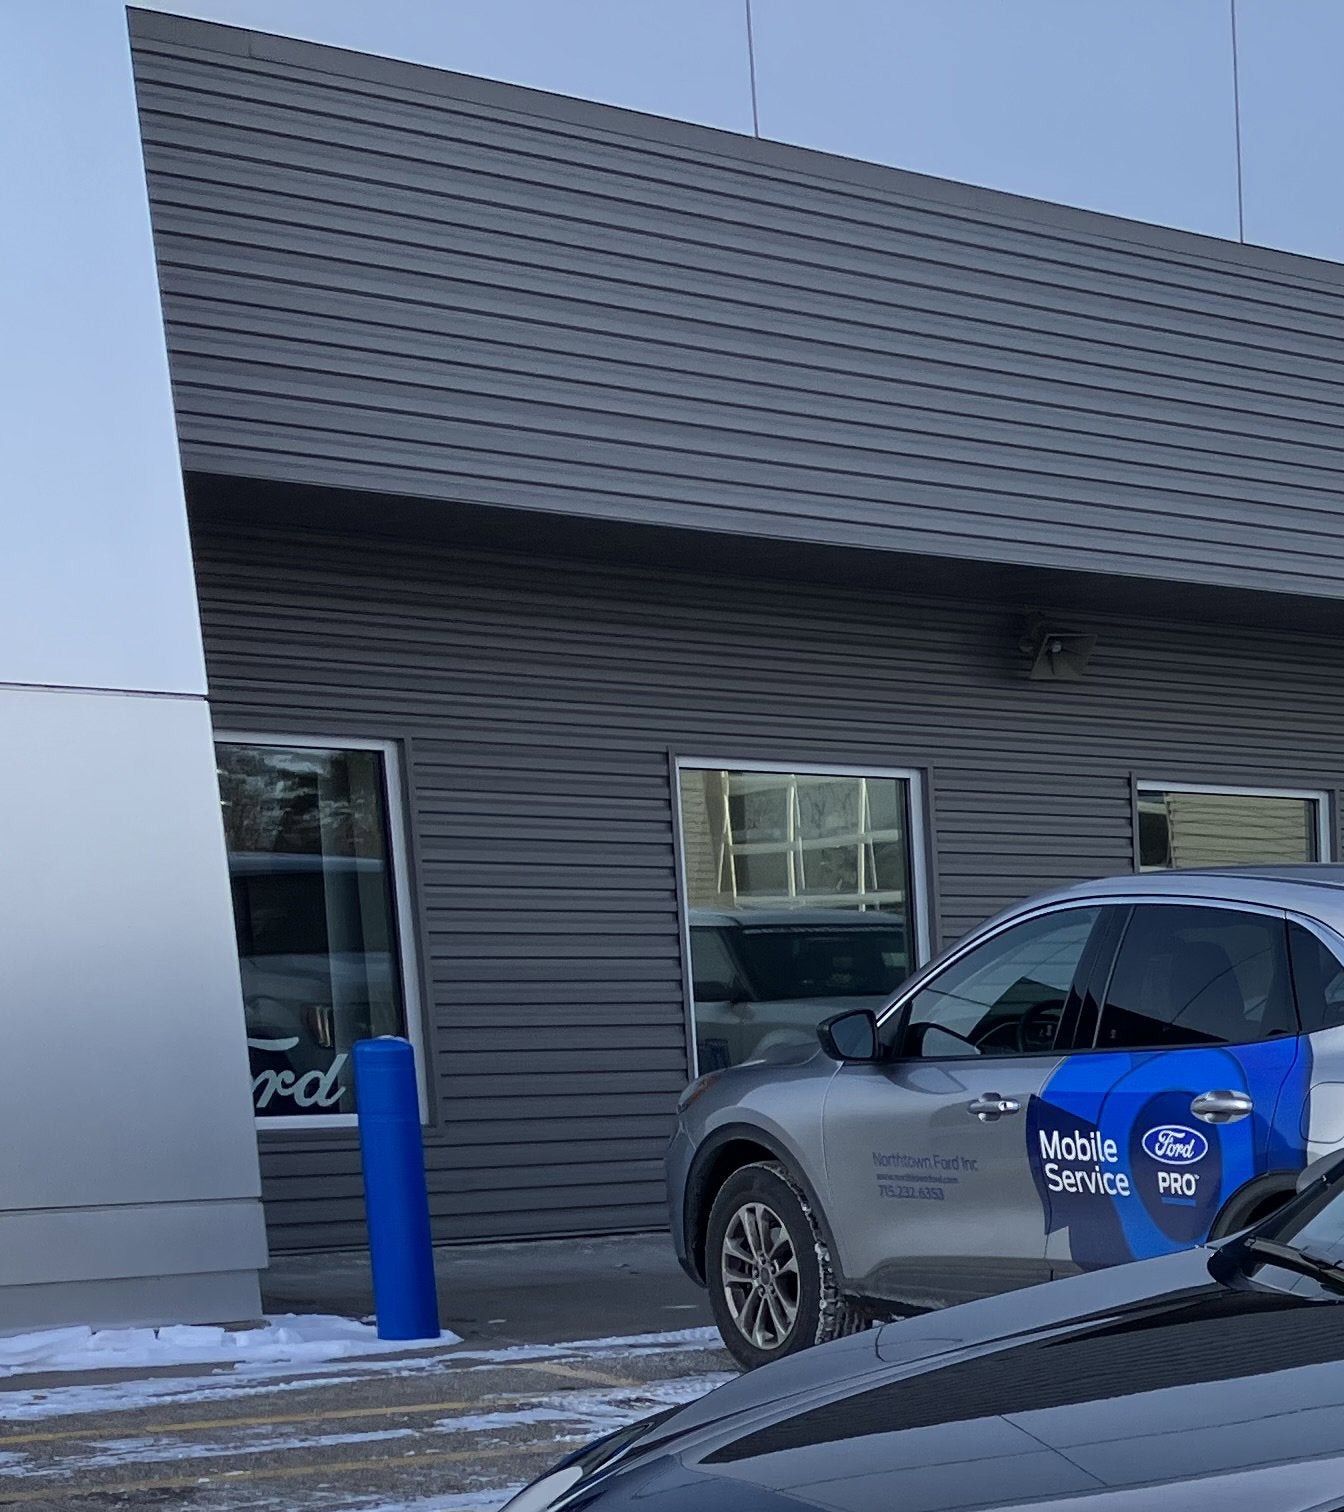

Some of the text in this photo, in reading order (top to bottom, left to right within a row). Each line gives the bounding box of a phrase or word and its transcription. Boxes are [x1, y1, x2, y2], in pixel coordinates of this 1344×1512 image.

[1039, 1130, 1119, 1163] Mobile
[1154, 1130, 1196, 1159] Ford
[932, 1154, 960, 1170] Ford
[1044, 1163, 1130, 1197] Service
